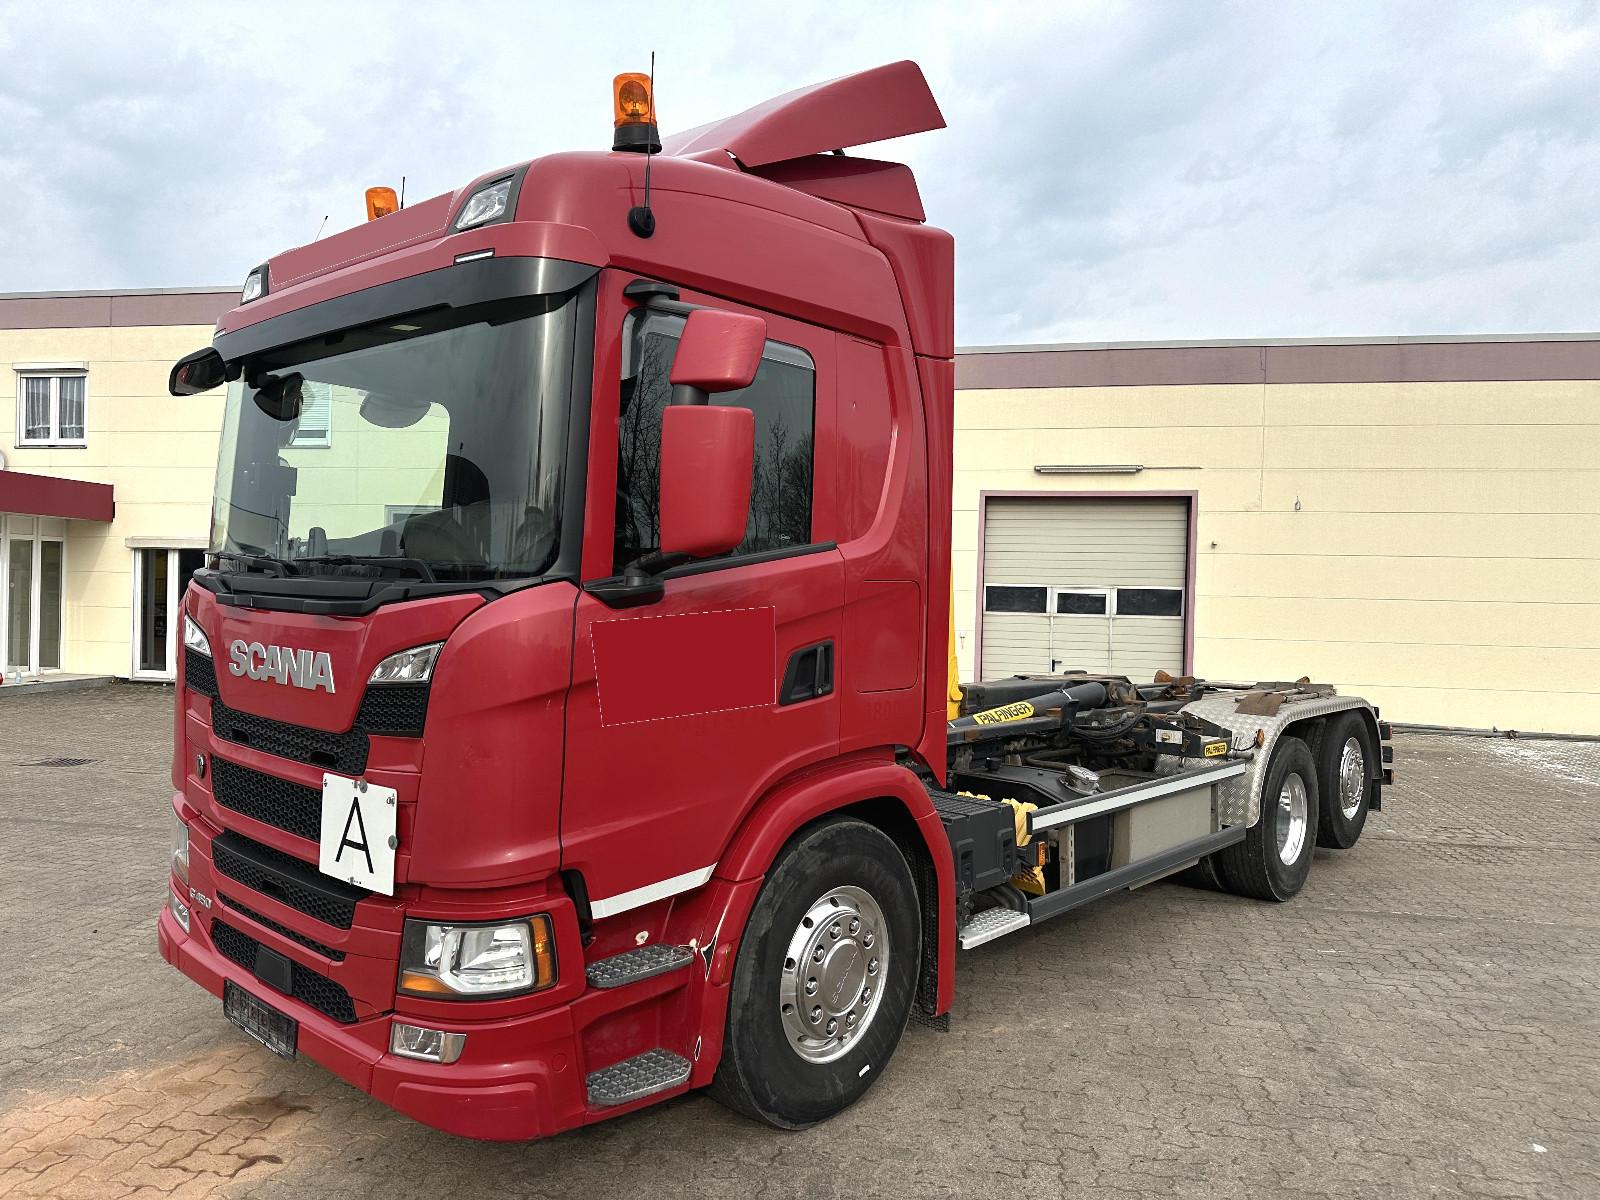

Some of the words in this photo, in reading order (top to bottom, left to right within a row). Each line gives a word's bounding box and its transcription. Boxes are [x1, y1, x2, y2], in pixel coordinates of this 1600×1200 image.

[229, 639, 336, 694] SCANIA
[976, 702, 1032, 725] PALFINGER
[335, 796, 374, 874] A
